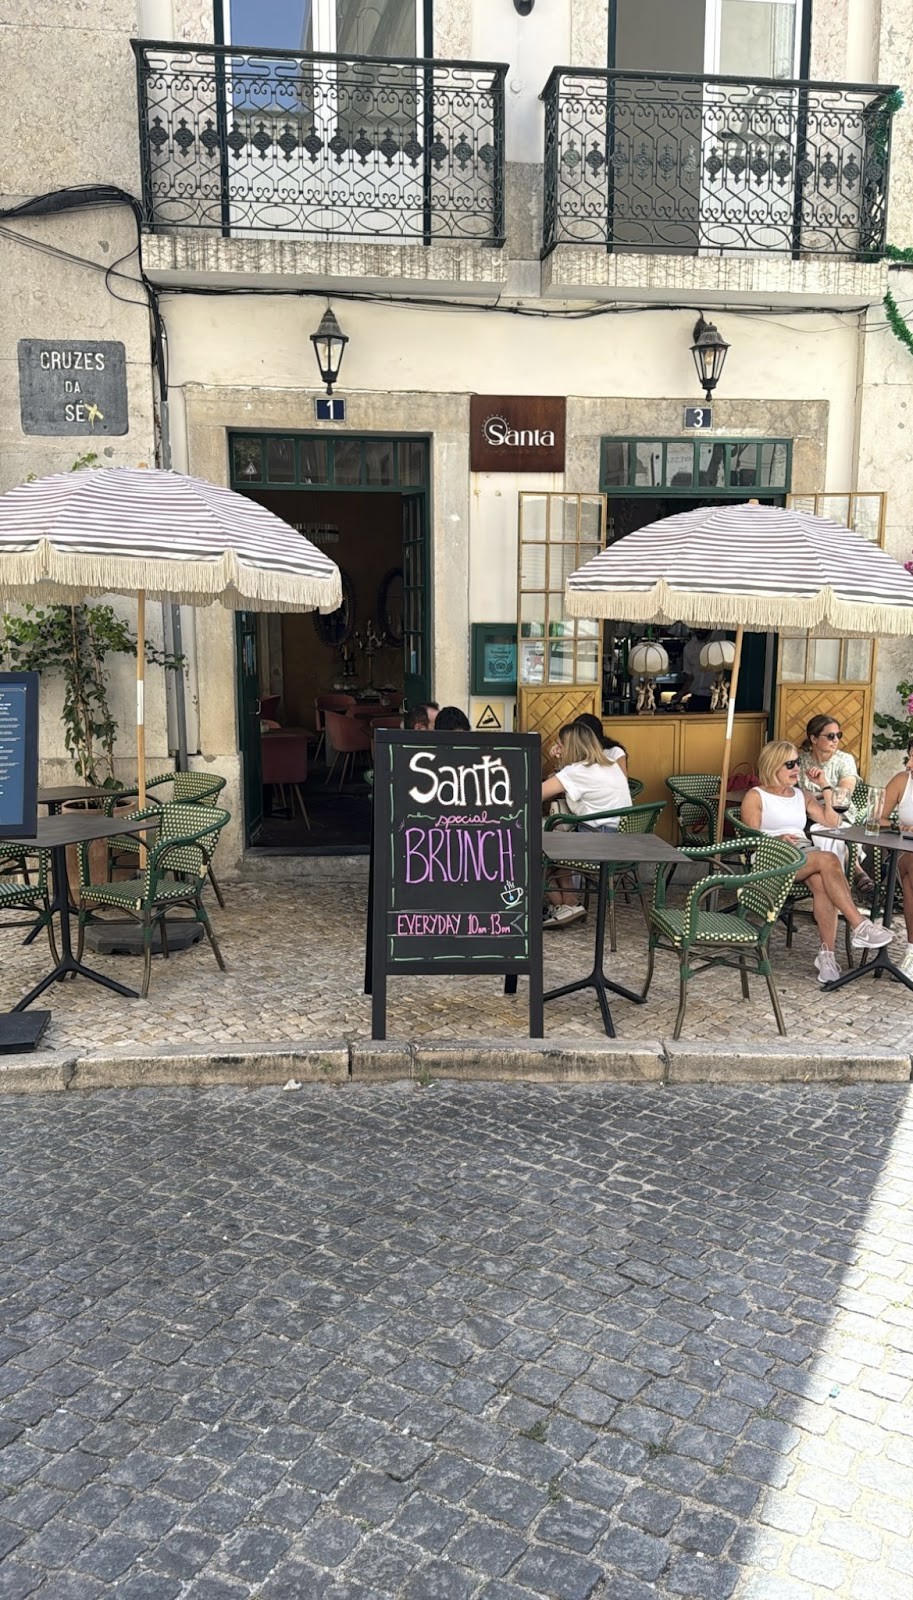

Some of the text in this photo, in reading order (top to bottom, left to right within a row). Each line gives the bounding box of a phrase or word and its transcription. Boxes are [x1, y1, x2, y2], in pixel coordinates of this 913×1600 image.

[40, 351, 105, 371] CRUZES
[65, 381, 81, 393] DA
[65, 400, 86, 422] SÉ
[326, 400, 334, 420] 1
[693, 408, 704, 428] 3
[487, 424, 555, 446] Santa
[408, 751, 514, 807] Santa
[435, 810, 501, 829] special
[405, 827, 515, 884] BRUNCH
[397, 914, 461, 935] EVERYDAY
